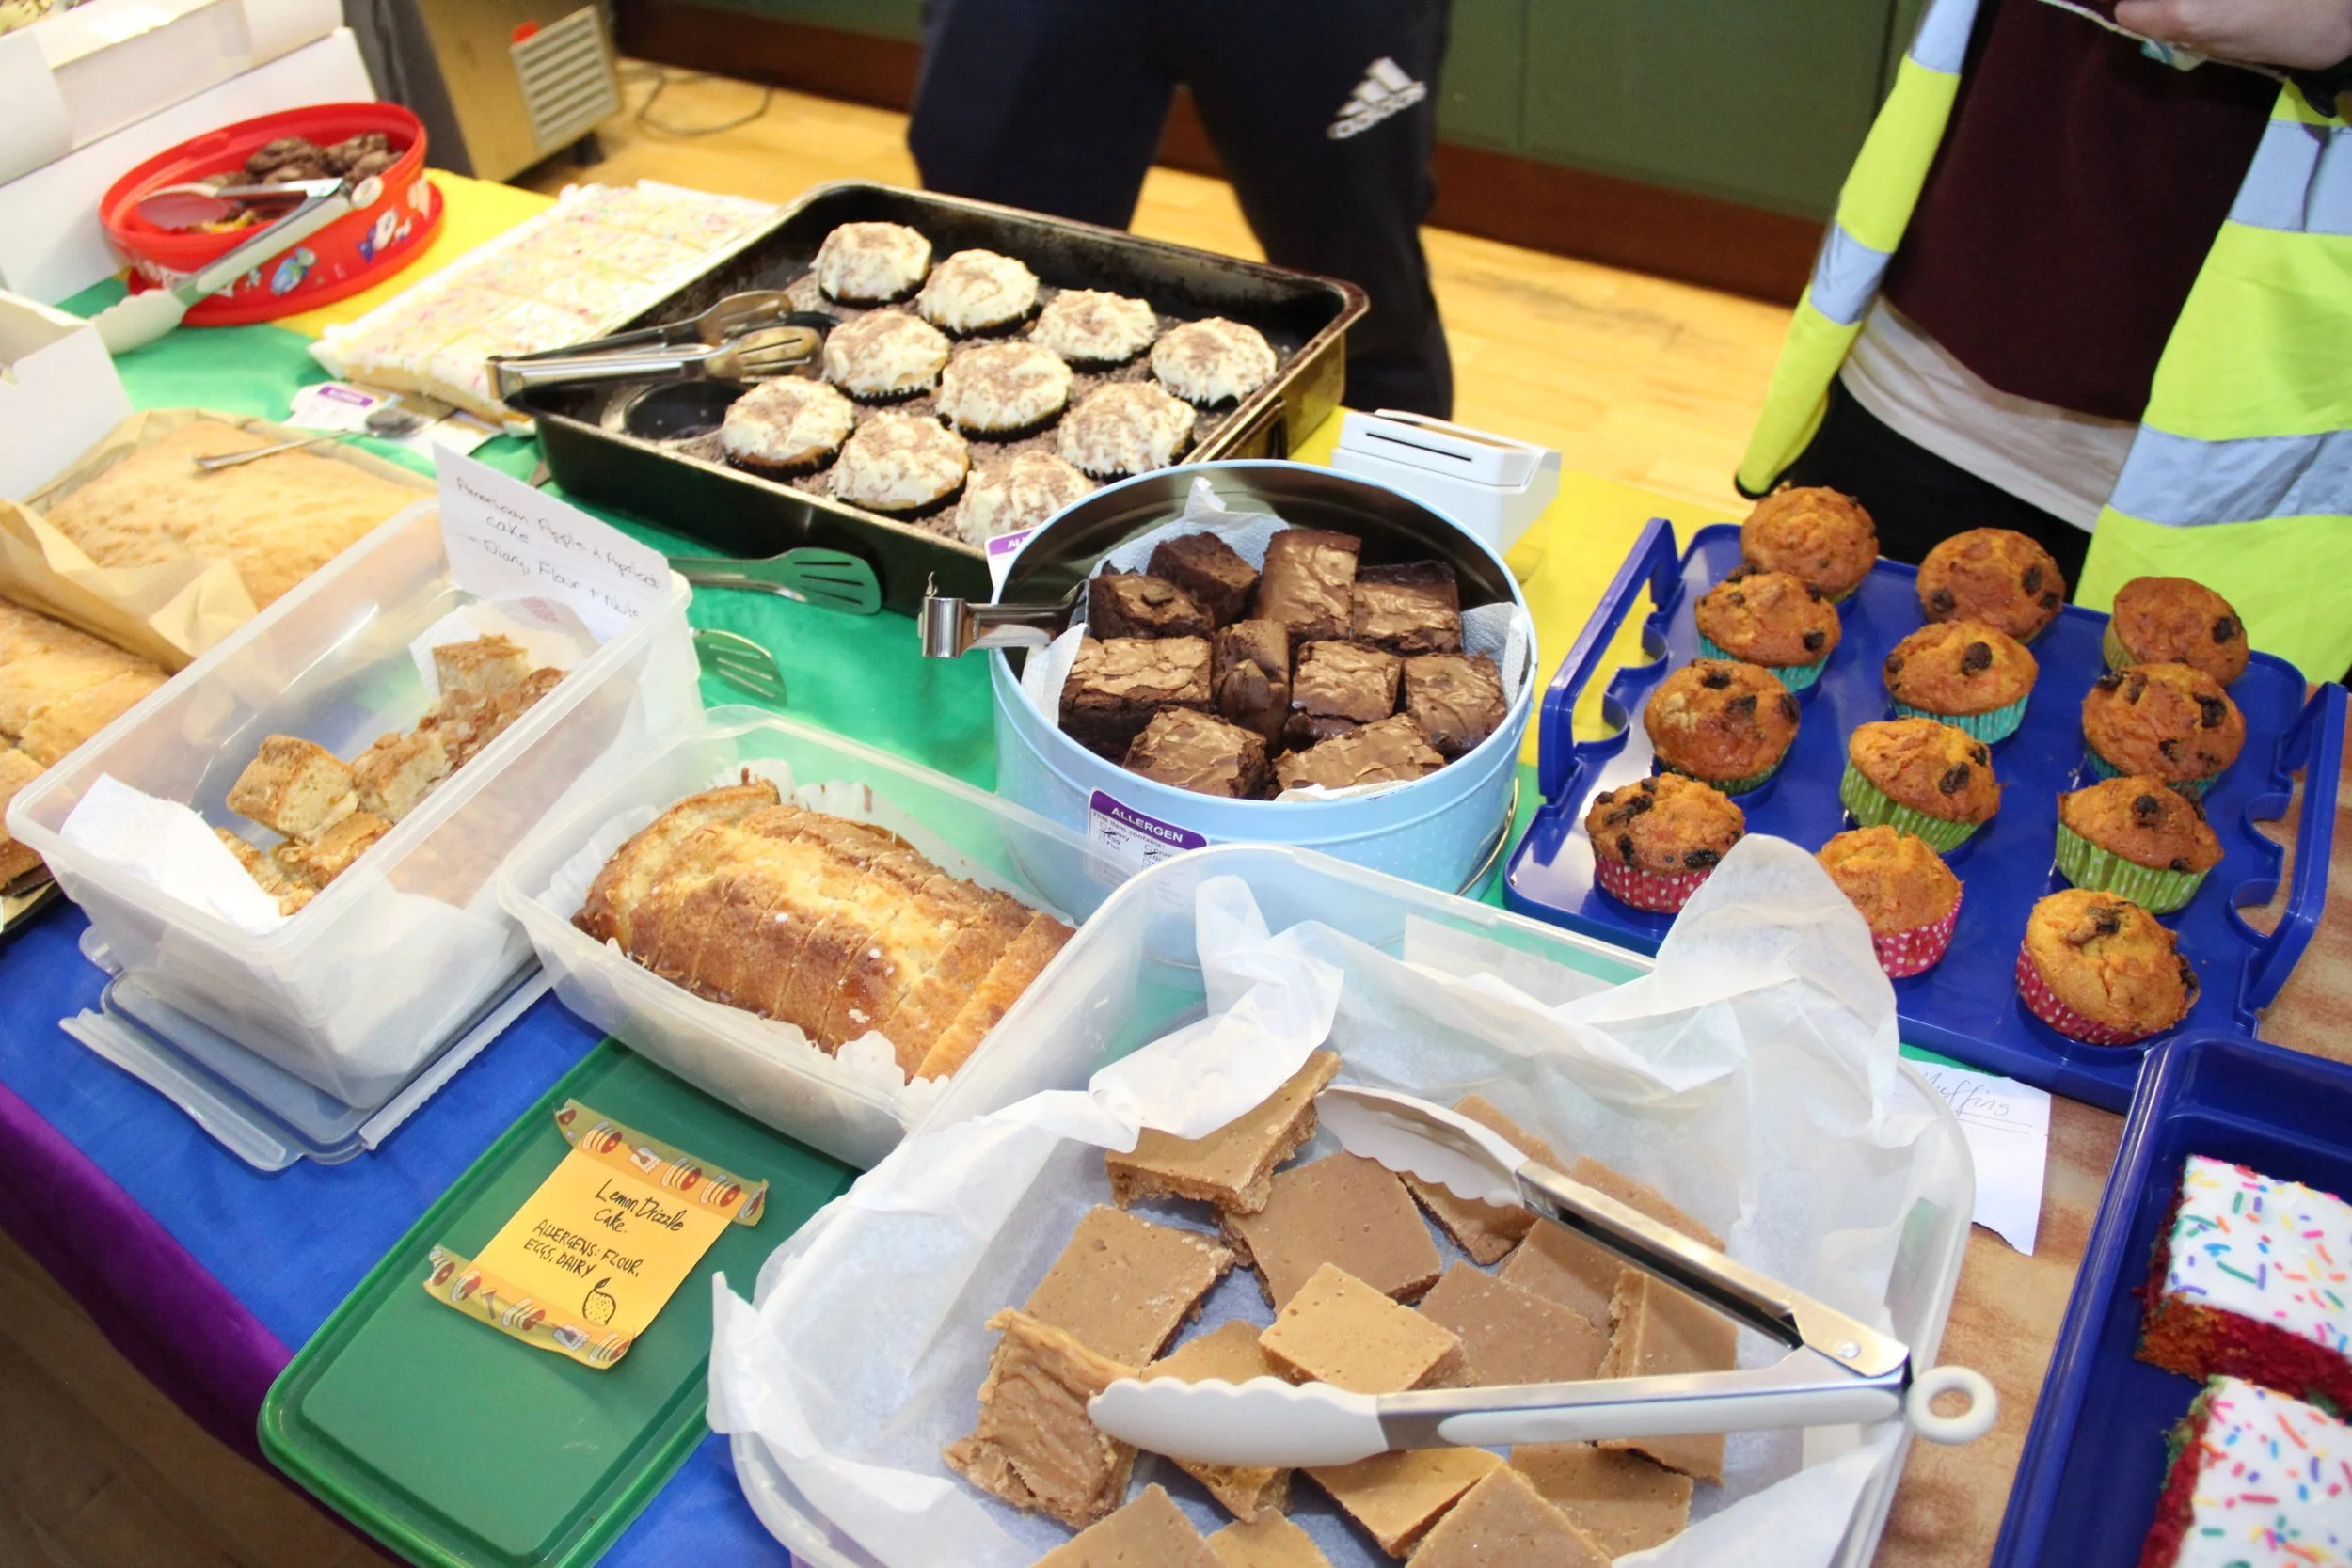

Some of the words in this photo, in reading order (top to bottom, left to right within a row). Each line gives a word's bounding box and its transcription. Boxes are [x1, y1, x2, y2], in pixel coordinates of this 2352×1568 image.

[1111, 807, 1184, 843] ALLERGEN
[595, 1178, 639, 1212] Lemon
[635, 1196, 688, 1232] Drizzle
[532, 1219, 601, 1258] ALLERGENS:
[555, 1252, 596, 1279] DAIRY
